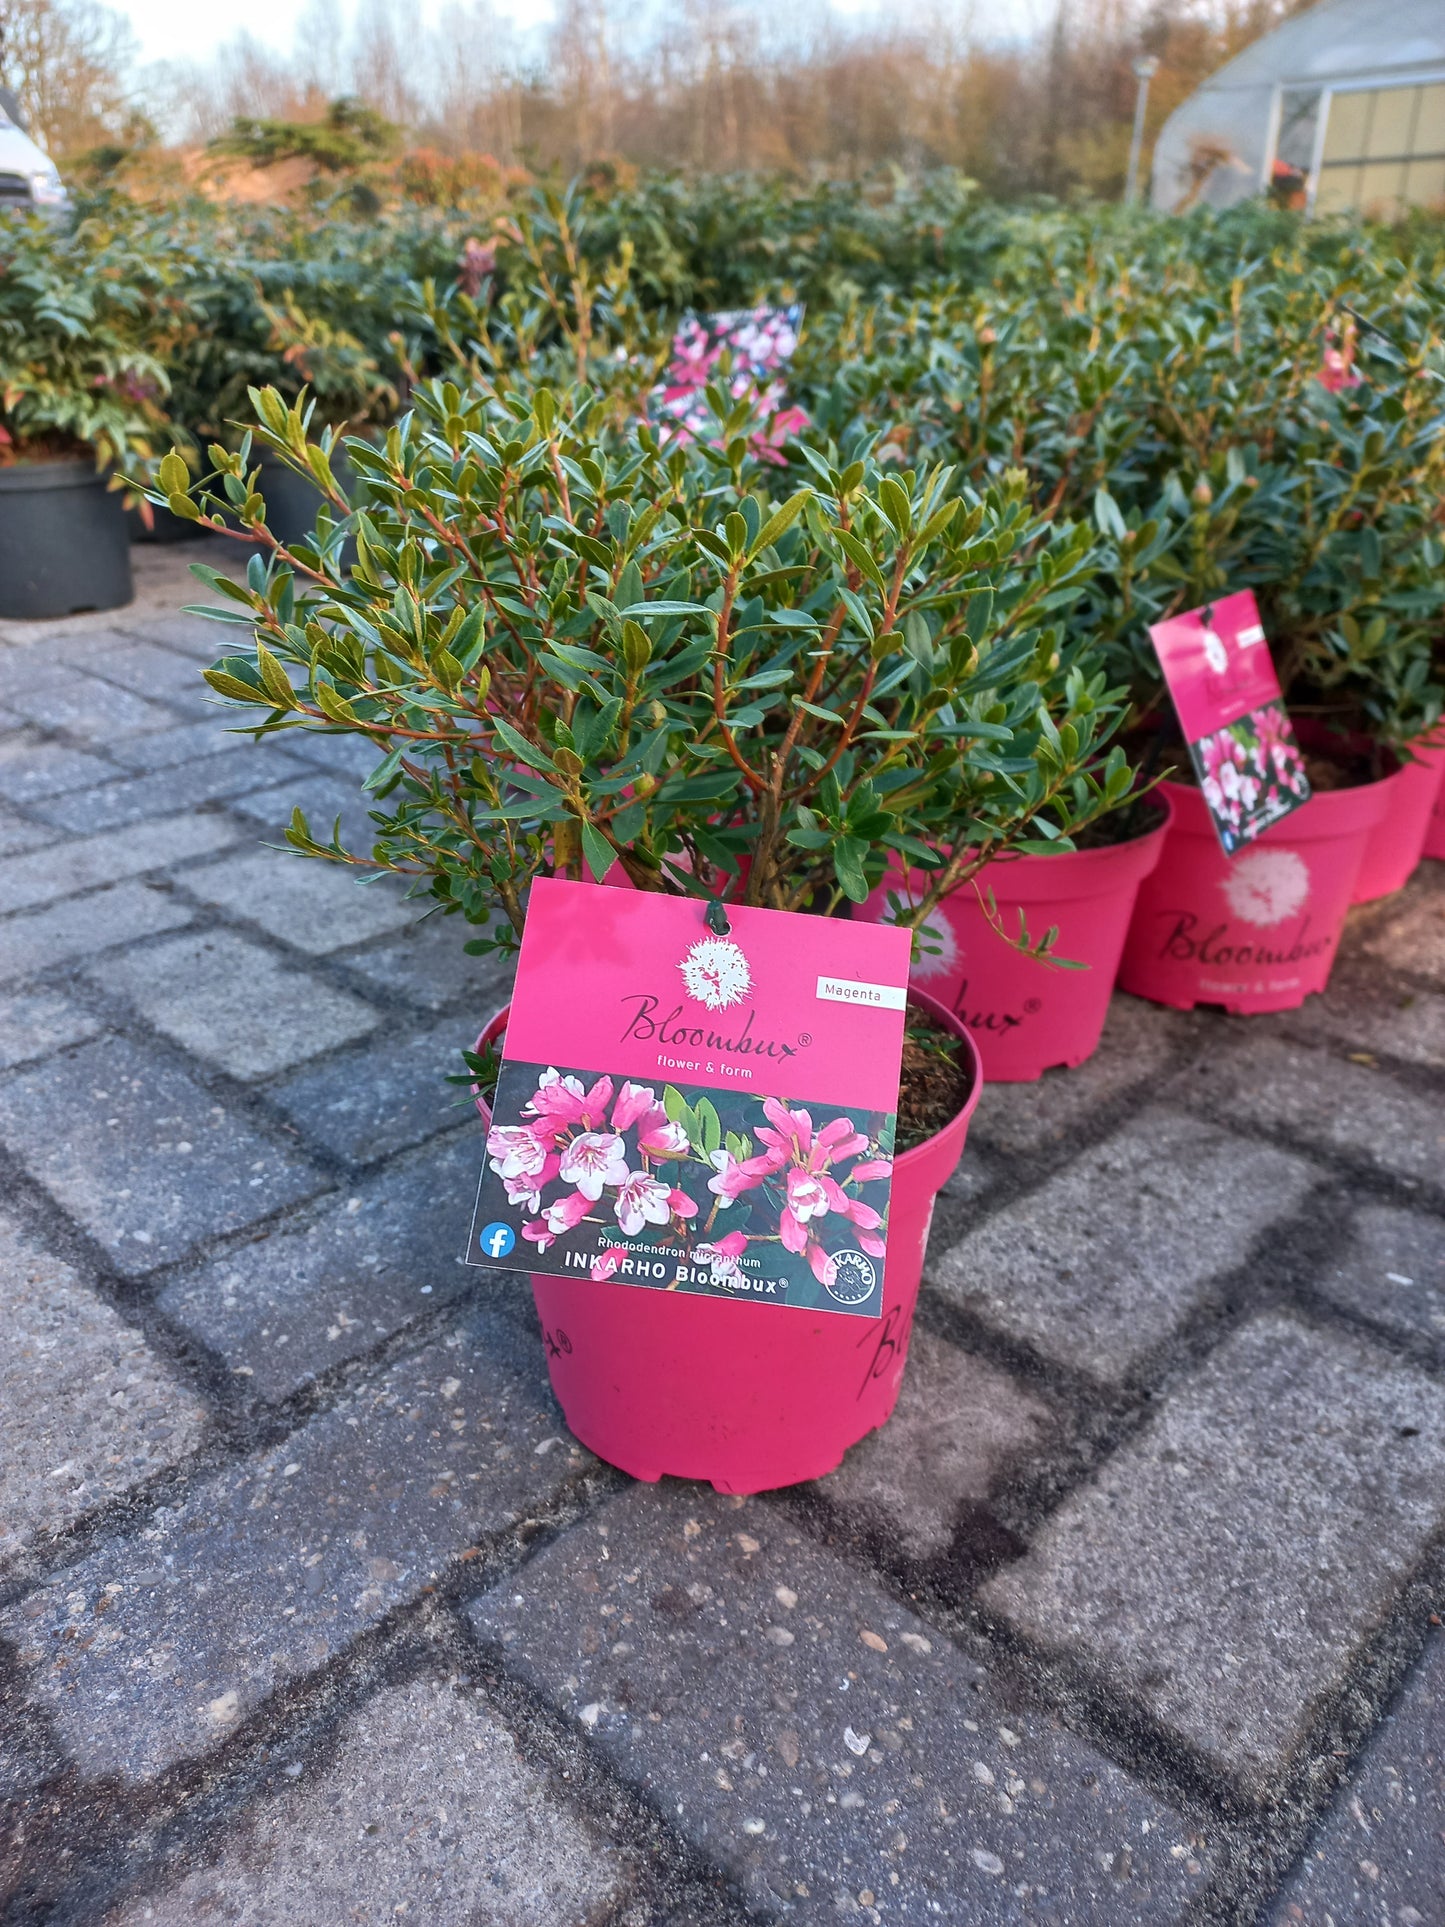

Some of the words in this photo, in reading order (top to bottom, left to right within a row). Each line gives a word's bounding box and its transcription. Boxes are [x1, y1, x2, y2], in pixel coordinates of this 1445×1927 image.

[824, 983, 881, 1001] Magenta
[656, 1054, 701, 1072] flower
[705, 1062, 715, 1074] &
[719, 1063, 753, 1079] form
[564, 1250, 667, 1279] INKARHO
[597, 1236, 686, 1258] Rhododendron
[688, 1249, 762, 1269] micranthum
[826, 1253, 873, 1286] INKARHO
